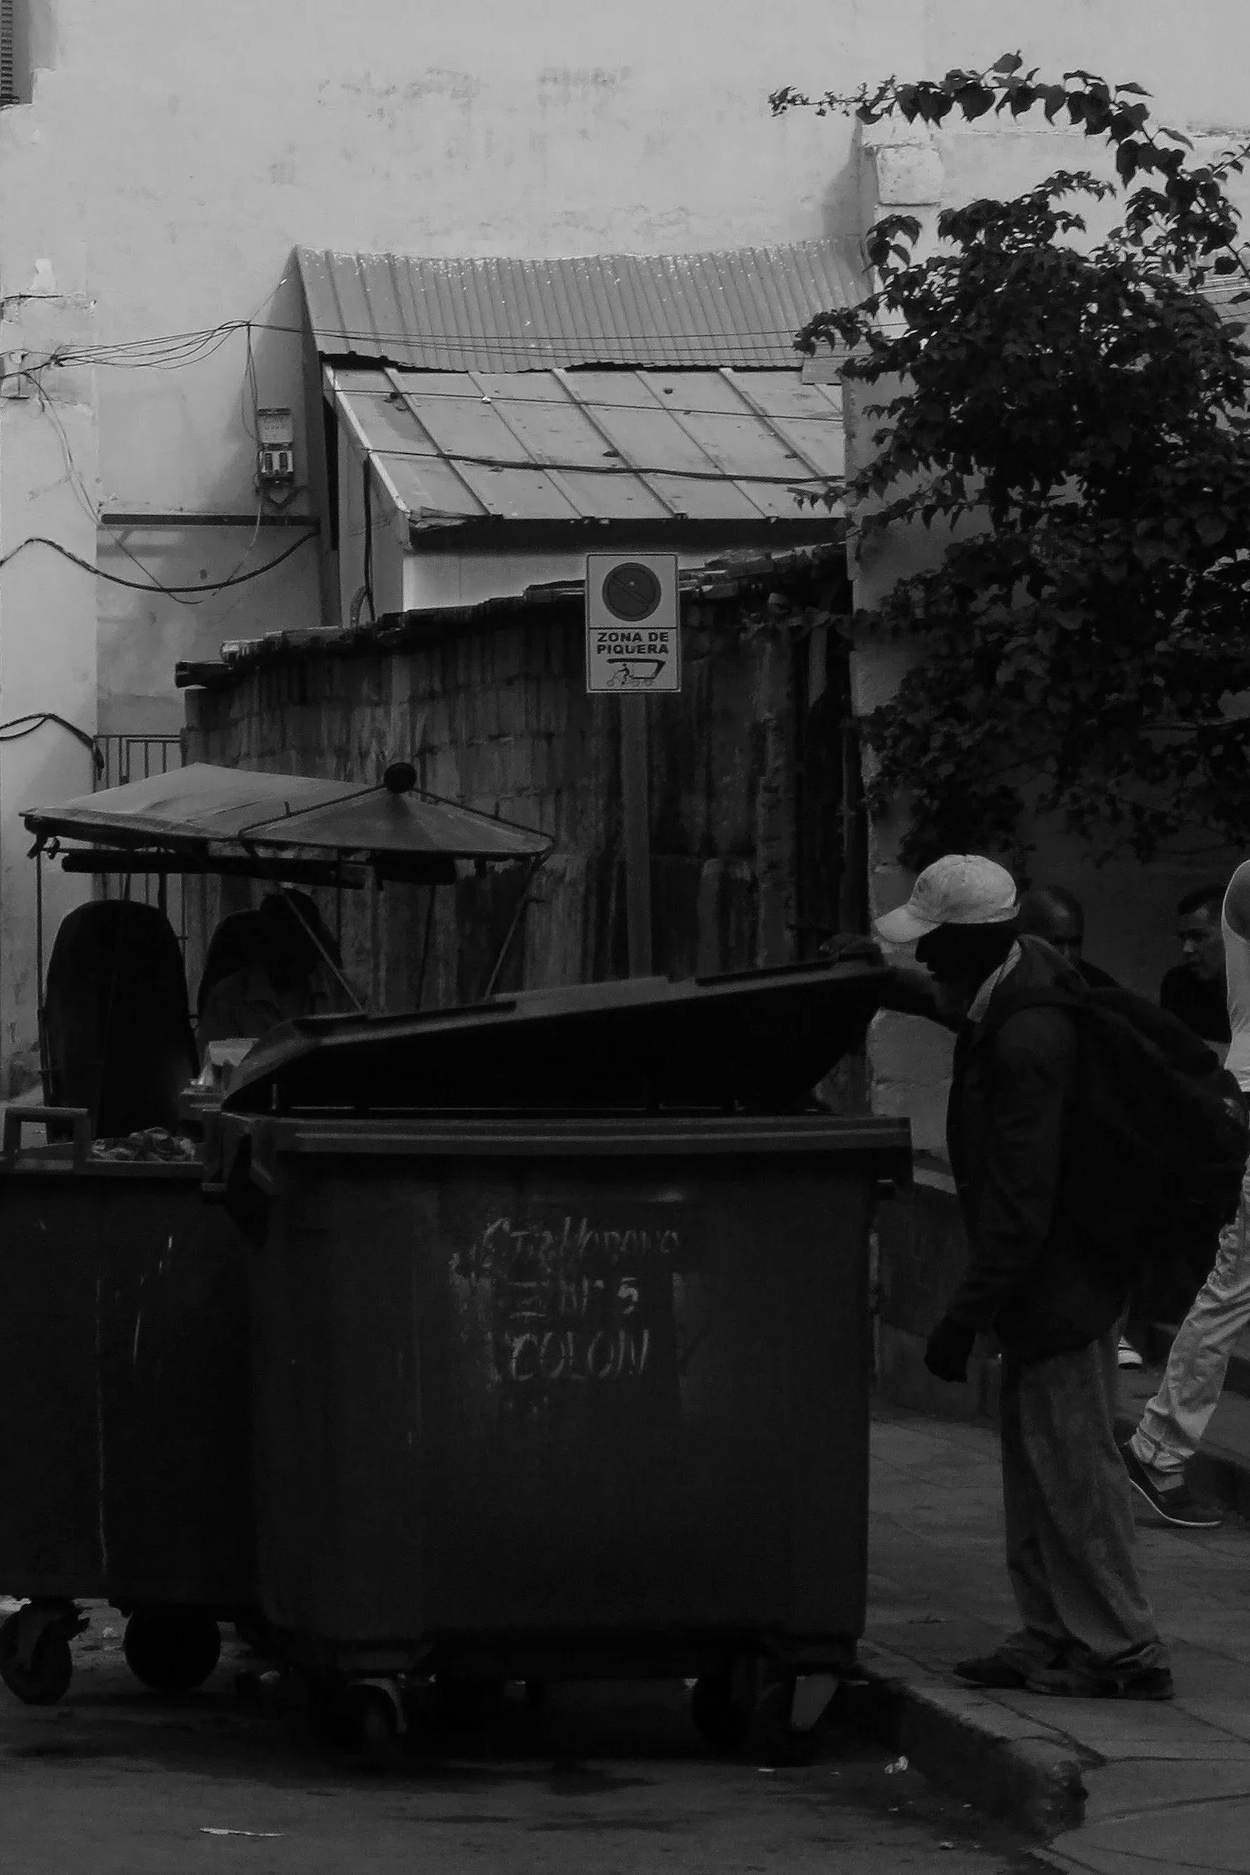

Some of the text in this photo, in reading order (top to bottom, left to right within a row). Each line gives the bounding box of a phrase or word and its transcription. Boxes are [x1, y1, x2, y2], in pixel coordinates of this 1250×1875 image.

[597, 632, 669, 643] ZONA DE
[596, 643, 670, 655] PIQUERA
